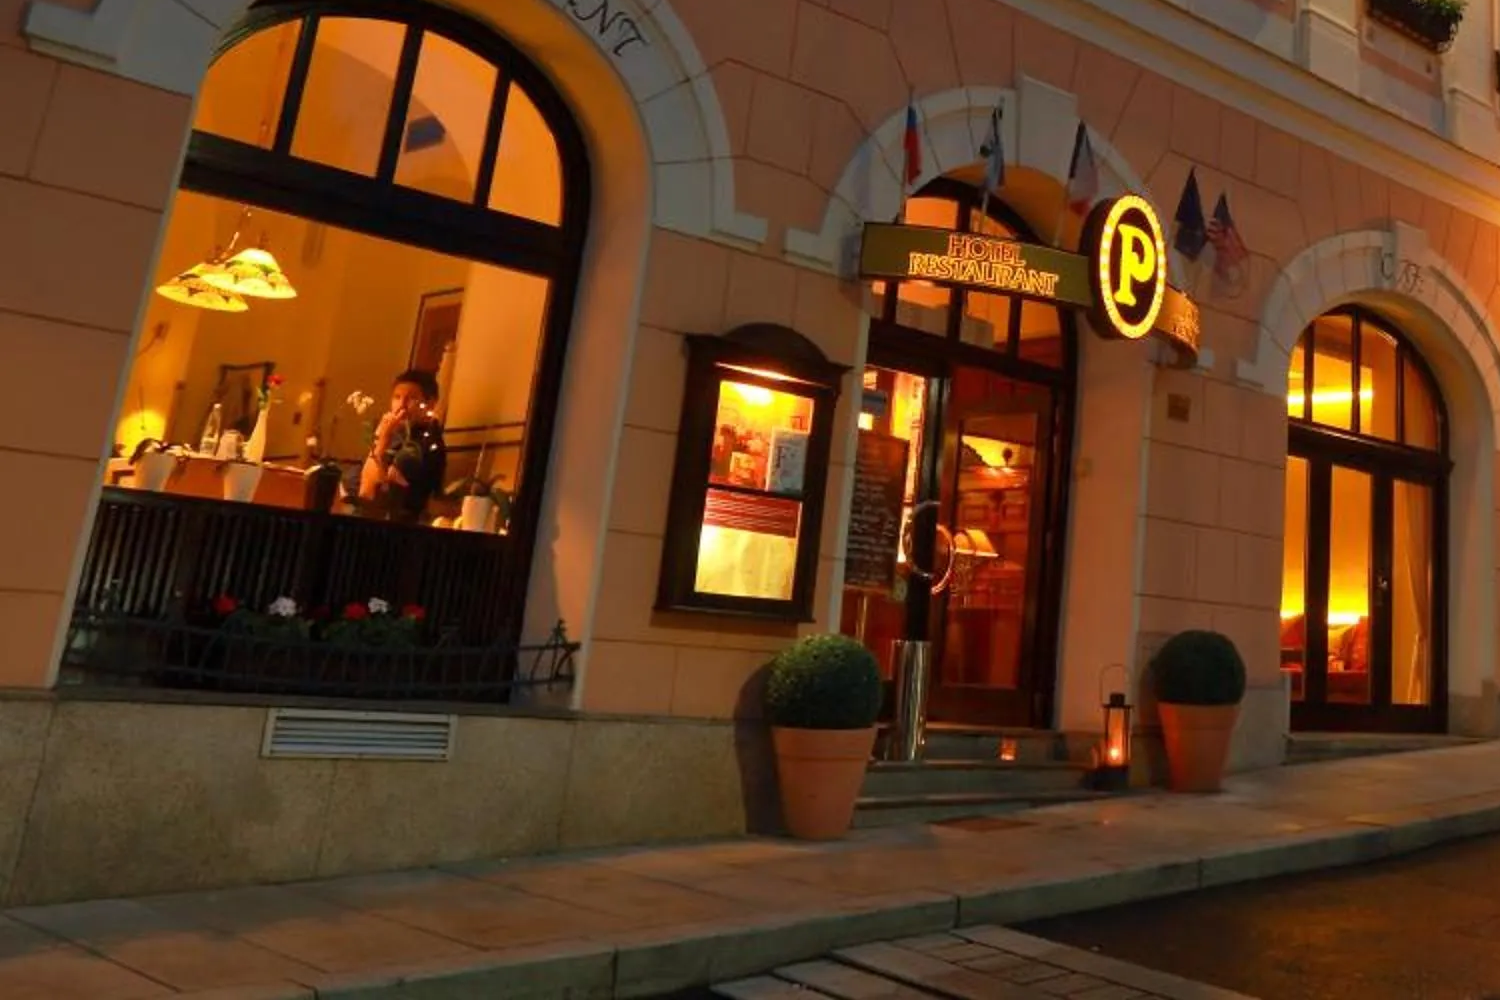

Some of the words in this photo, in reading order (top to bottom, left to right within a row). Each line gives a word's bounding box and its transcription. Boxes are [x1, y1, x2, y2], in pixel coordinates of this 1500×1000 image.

[948, 232, 1027, 267] HOTEL
[1113, 222, 1157, 307] P
[907, 251, 1060, 297] RESTAURANT
